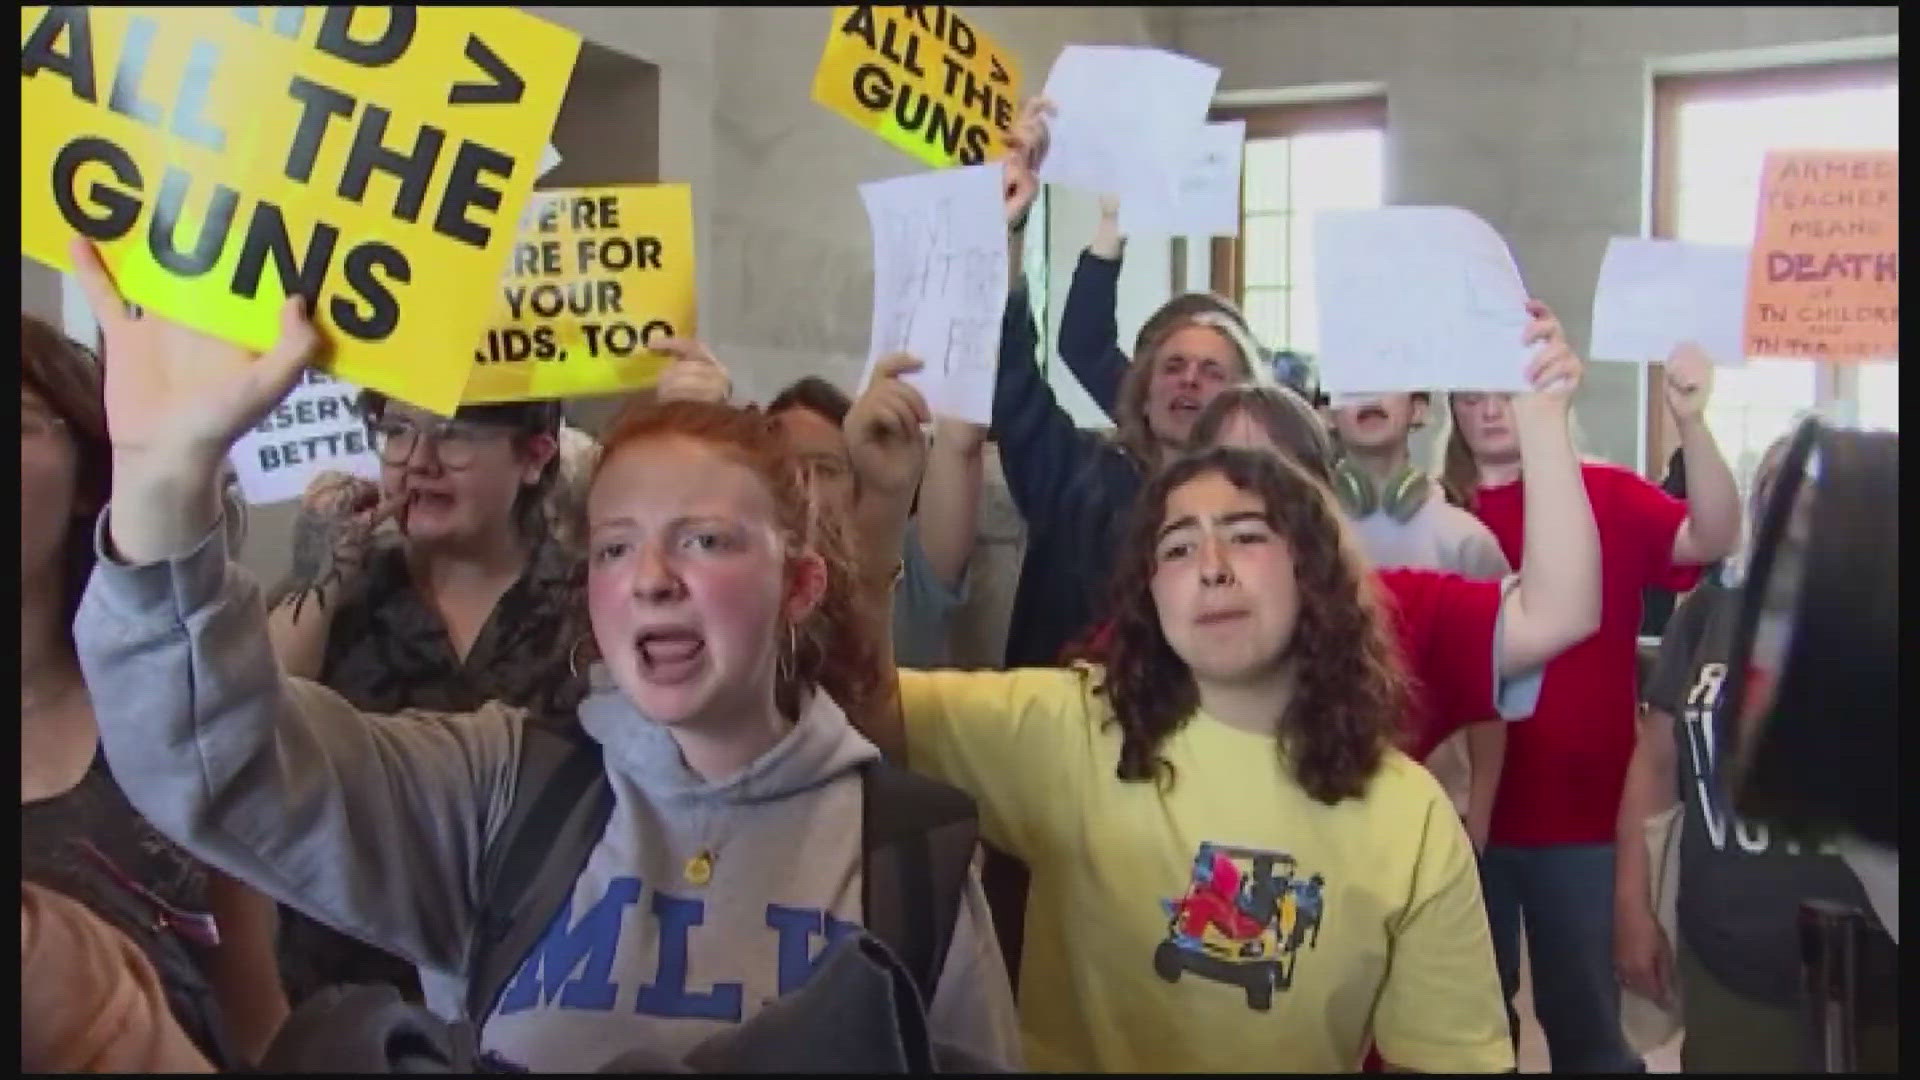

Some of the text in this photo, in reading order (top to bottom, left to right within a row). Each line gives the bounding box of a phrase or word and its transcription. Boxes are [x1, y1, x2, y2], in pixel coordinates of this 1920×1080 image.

[841, 6, 1013, 131] ALL THE
[22, 6, 515, 249] ALL THE
[853, 63, 990, 165] GUNS
[522, 195, 620, 233] E'RE
[51, 135, 411, 341] GUNS
[512, 235, 663, 276] RE FOR
[1768, 252, 1897, 283] DEATH
[503, 279, 624, 320] YOUR
[475, 324, 569, 364] IDS,
[258, 426, 377, 473] BETTE
